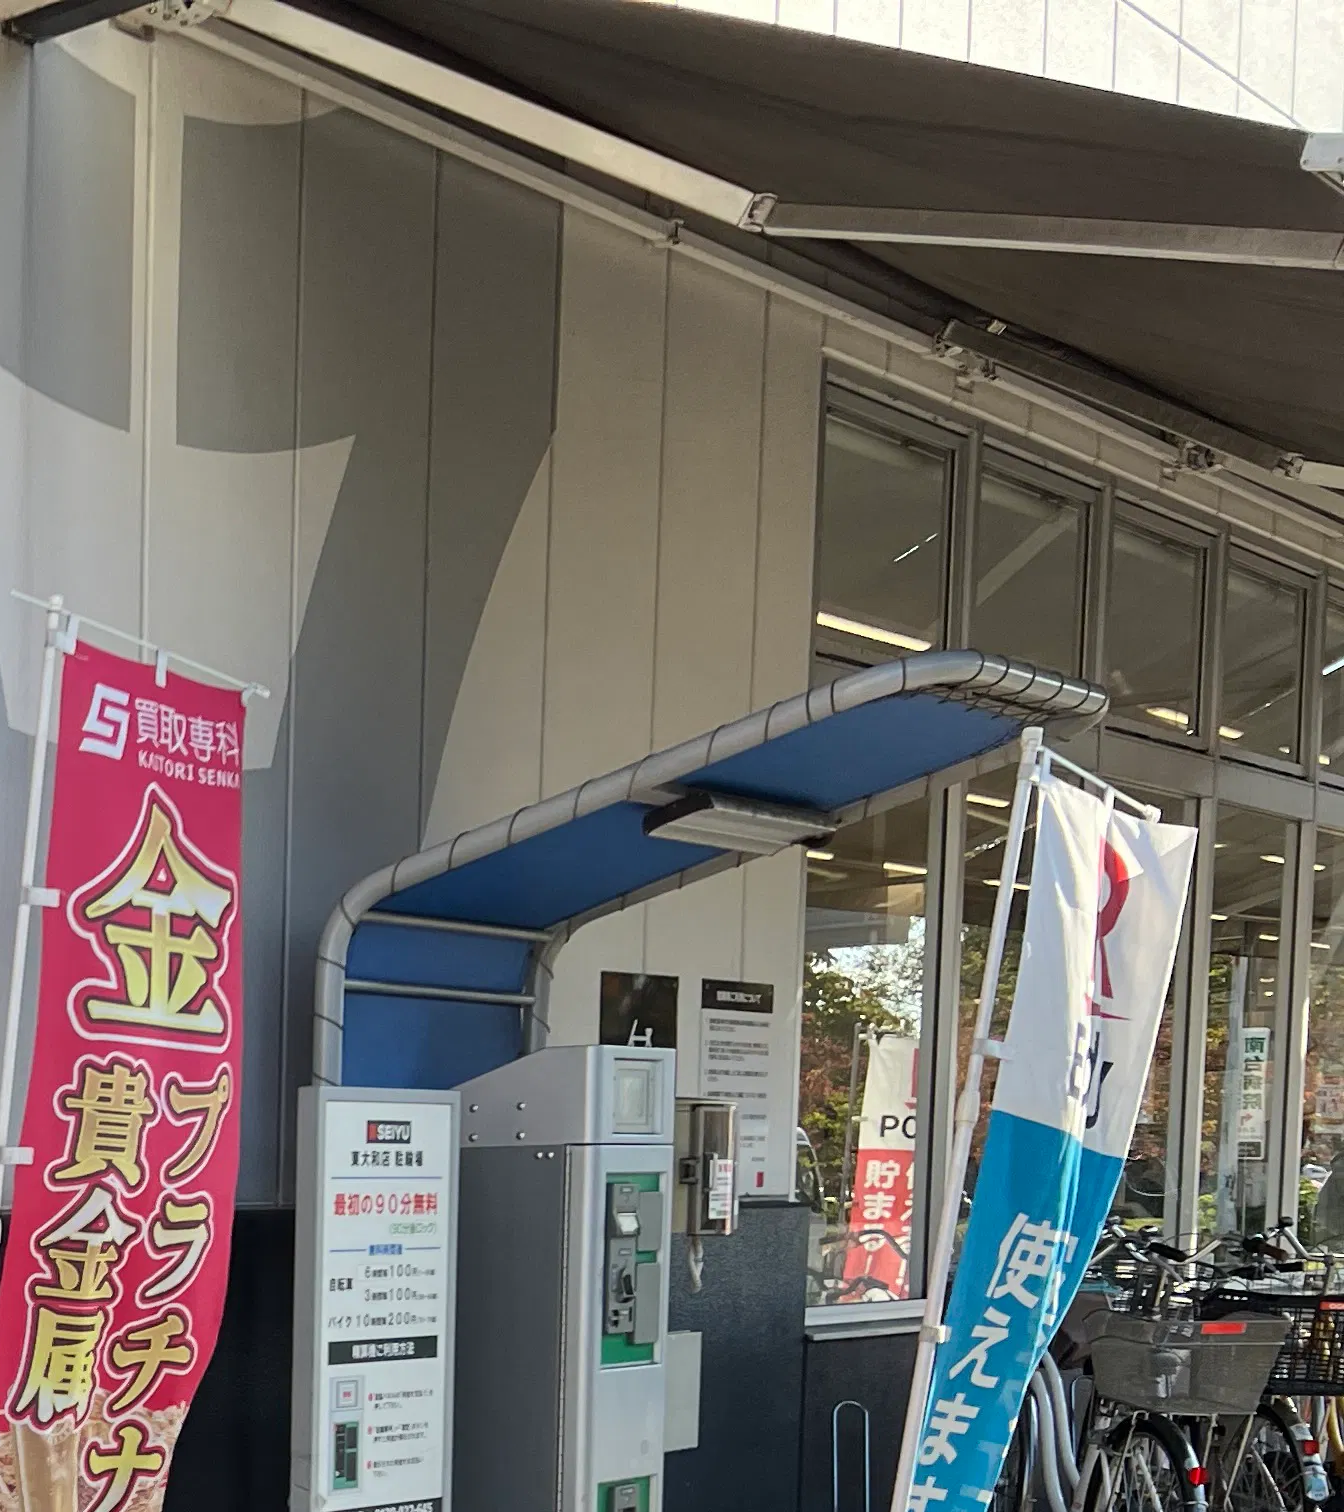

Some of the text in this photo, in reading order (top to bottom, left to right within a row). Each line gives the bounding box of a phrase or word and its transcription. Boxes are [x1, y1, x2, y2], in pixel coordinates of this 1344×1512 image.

[134, 697, 240, 768] 買取専科
[72, 787, 238, 1048] 金
[376, 1123, 411, 1141] SEIYU
[12, 1058, 157, 1428] 貴金属
[328, 1315, 353, 1329] バイク
